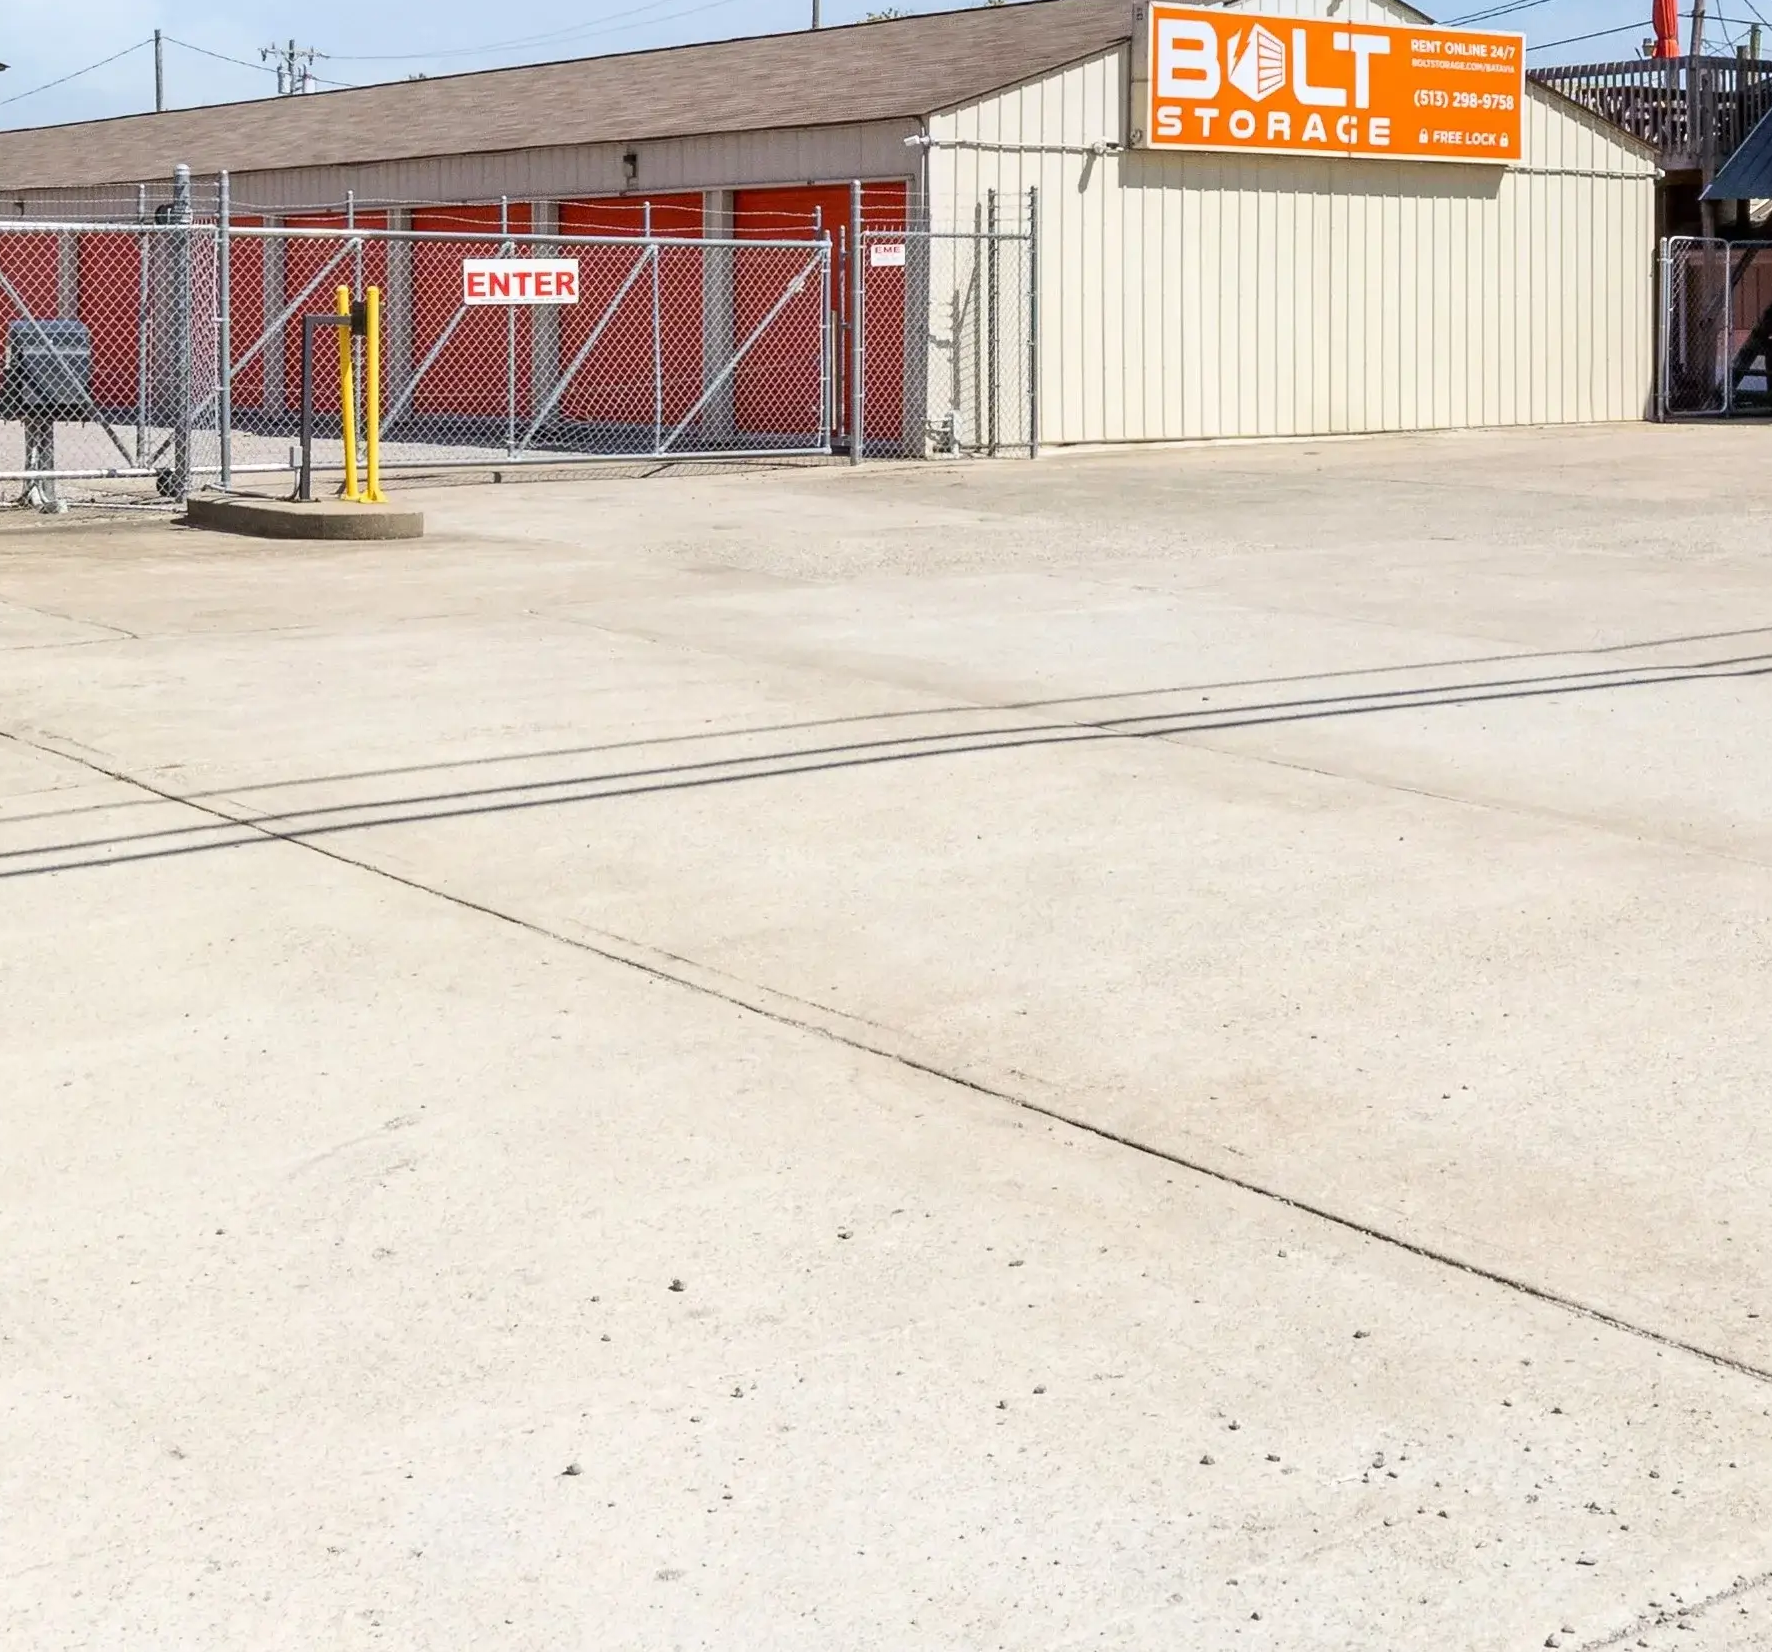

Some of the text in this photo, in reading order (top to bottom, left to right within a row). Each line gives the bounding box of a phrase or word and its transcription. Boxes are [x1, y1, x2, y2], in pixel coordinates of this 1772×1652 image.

[1410, 38, 1516, 60] RENT ONLINE 24/7
[1156, 17, 1391, 110] BOLT
[1413, 89, 1515, 110] (513) 298-9758
[1156, 105, 1392, 145] STORAGE
[1432, 130, 1497, 146] FREE LOCK
[467, 271, 576, 297] ENTER
